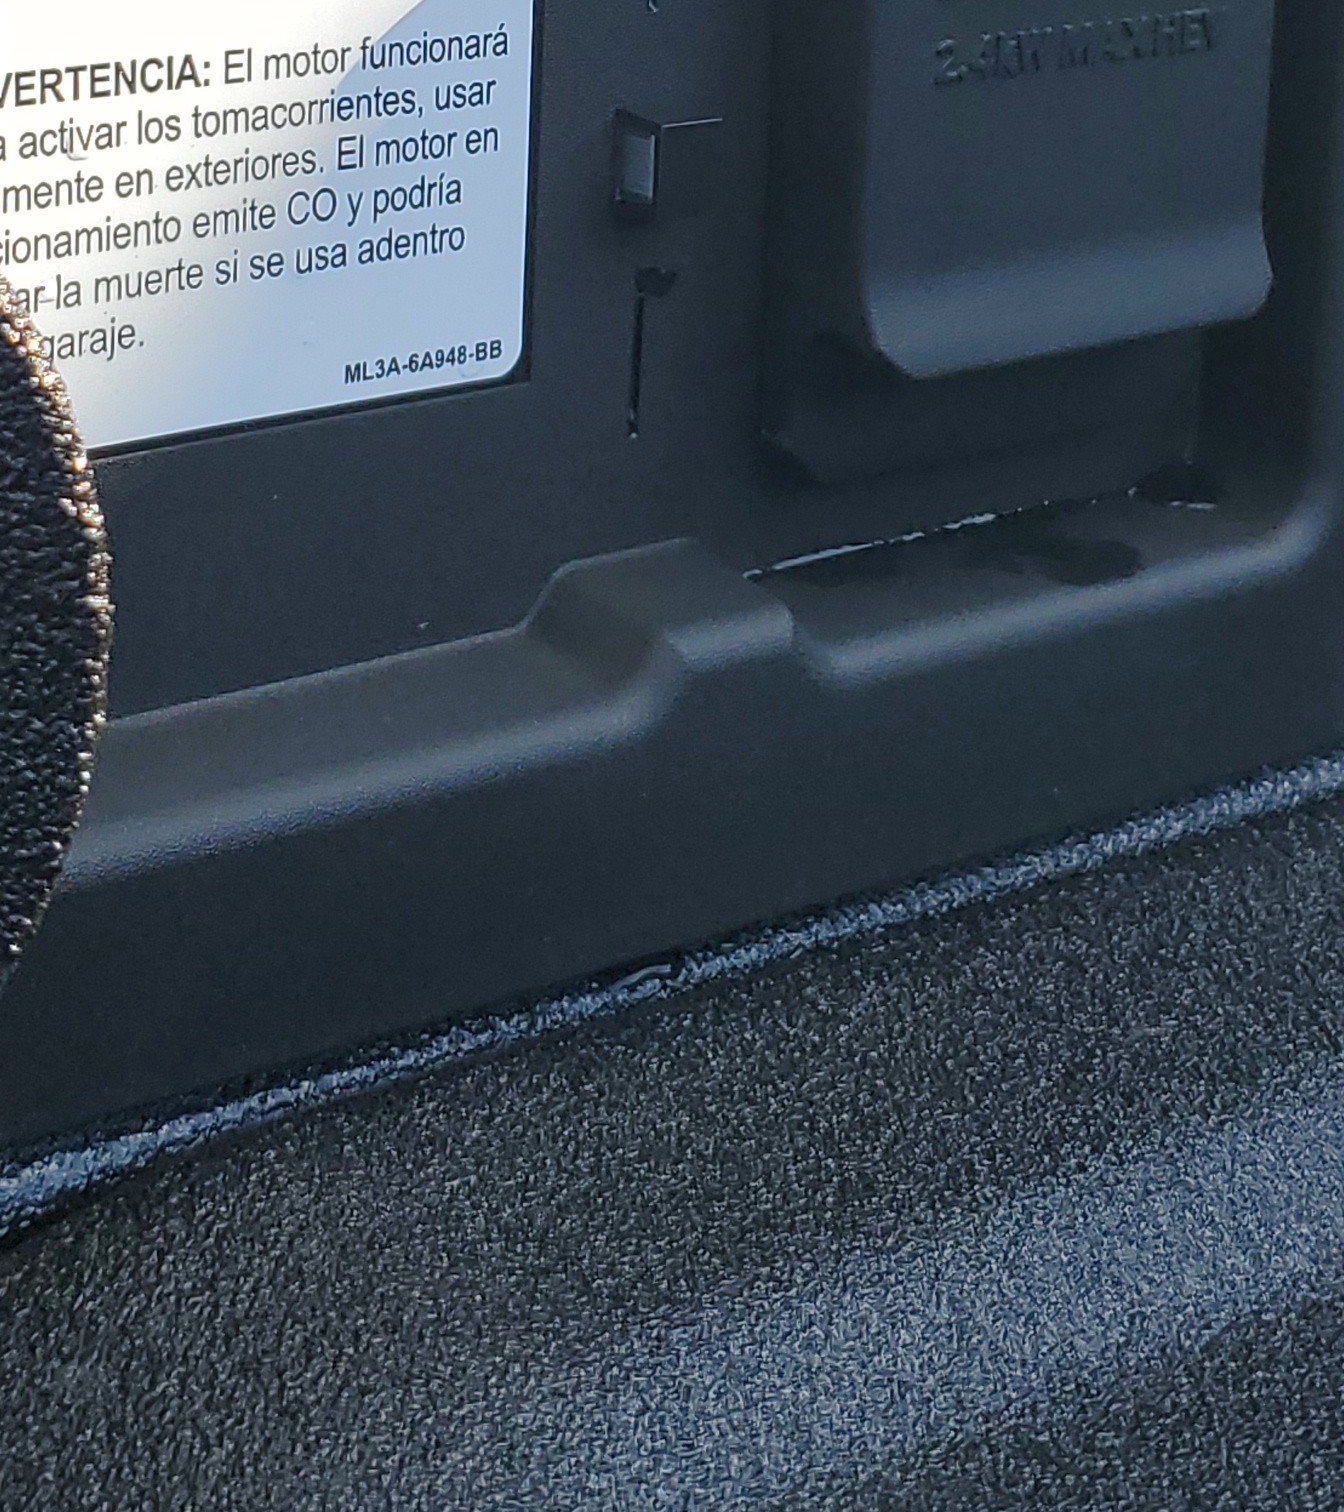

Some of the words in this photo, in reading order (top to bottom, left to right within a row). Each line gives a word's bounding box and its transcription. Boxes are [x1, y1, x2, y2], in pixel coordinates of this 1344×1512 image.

[224, 47, 252, 85] El
[264, 42, 352, 81] motor
[359, 22, 508, 71] funcionará
[18, 117, 128, 160] activar
[137, 110, 182, 145] los
[191, 87, 424, 139] tomacorrientes,
[435, 79, 497, 111] usar
[115, 168, 153, 199] en
[165, 147, 324, 192] exteriores.
[337, 134, 364, 171] El
[375, 128, 458, 167] motor
[465, 127, 499, 155] en
[192, 197, 277, 239] emite
[287, 187, 337, 225] CO
[346, 191, 364, 228] y
[372, 172, 462, 224] podría
[55, 274, 82, 310] la
[94, 262, 205, 304] muerte
[215, 249, 239, 286] si
[249, 252, 285, 280] se
[295, 243, 347, 275] usa
[357, 222, 466, 265] adentro
[344, 340, 503, 384] ML3A-6A948-BB
